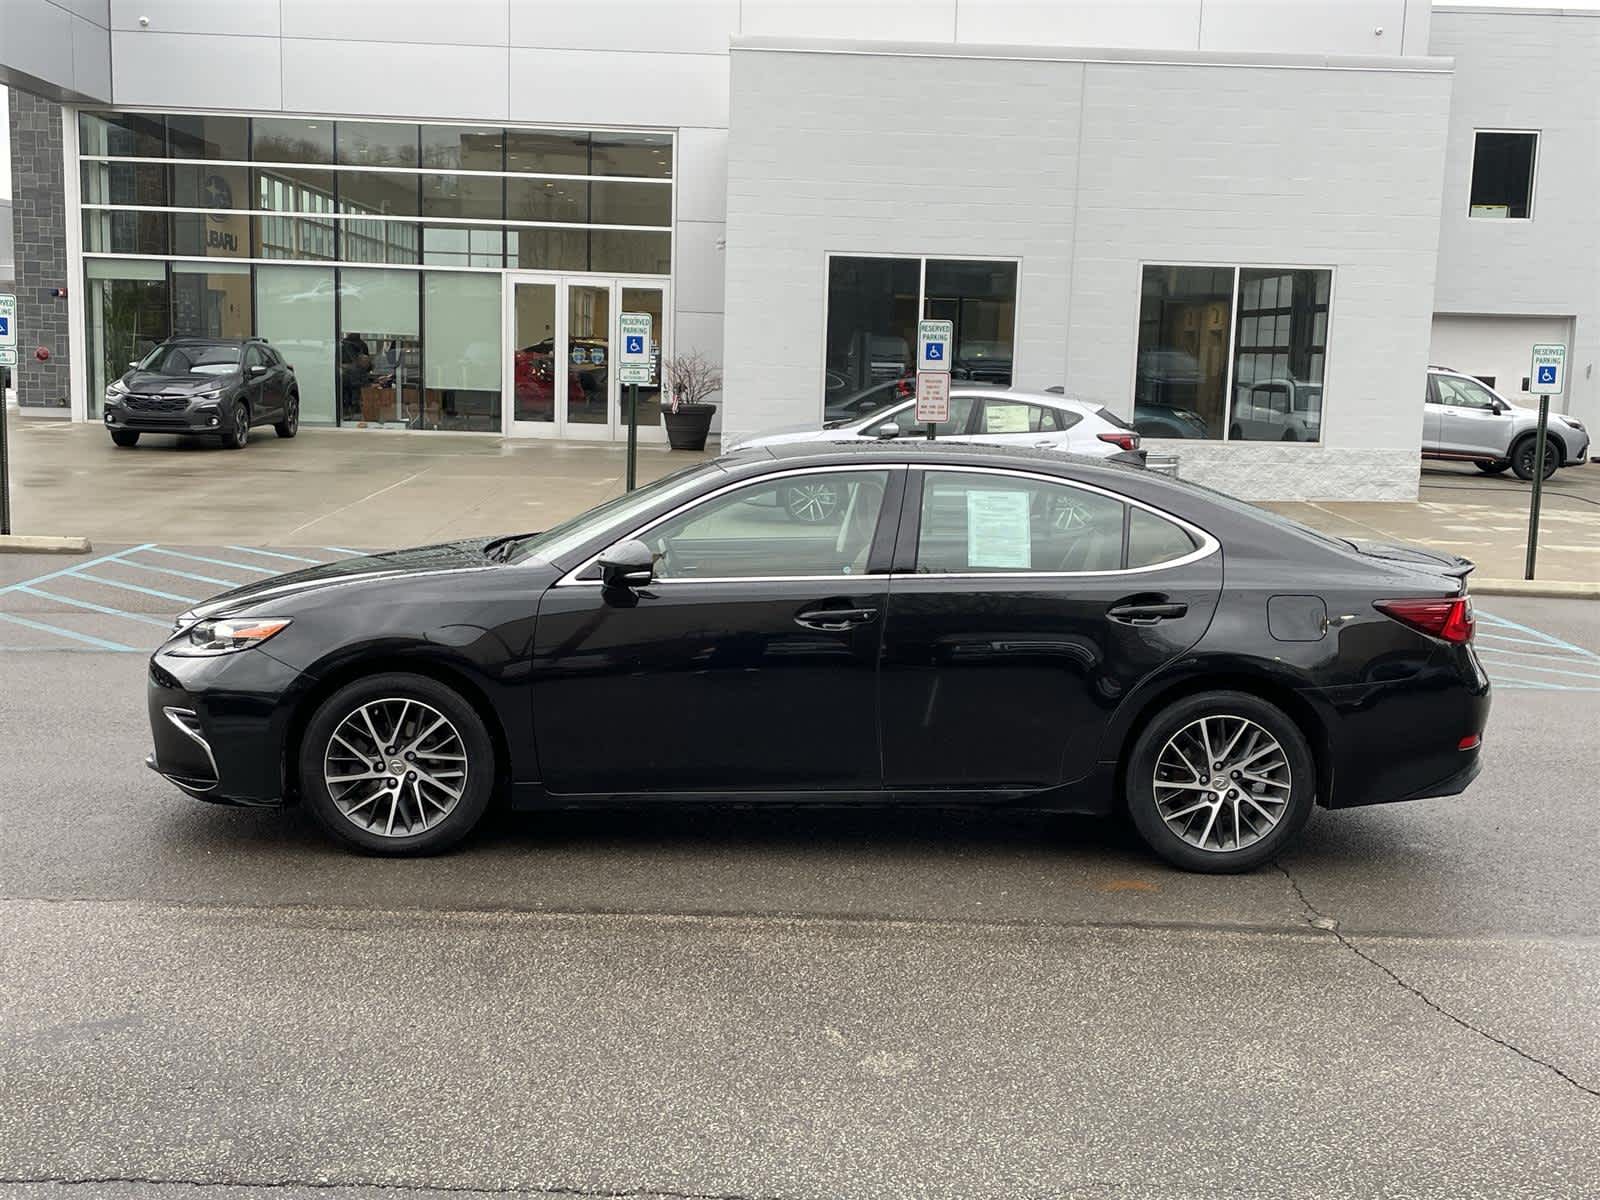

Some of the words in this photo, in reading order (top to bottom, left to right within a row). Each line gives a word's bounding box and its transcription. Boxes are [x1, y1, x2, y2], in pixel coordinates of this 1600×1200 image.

[206, 229, 238, 252] UBARU
[621, 318, 650, 326] RESERVED
[623, 326, 648, 335] PARKING
[921, 324, 950, 332] RESERVED
[922, 333, 948, 342] PARKING
[1534, 348, 1564, 356] RESERVED
[1535, 357, 1561, 365] PARKING
